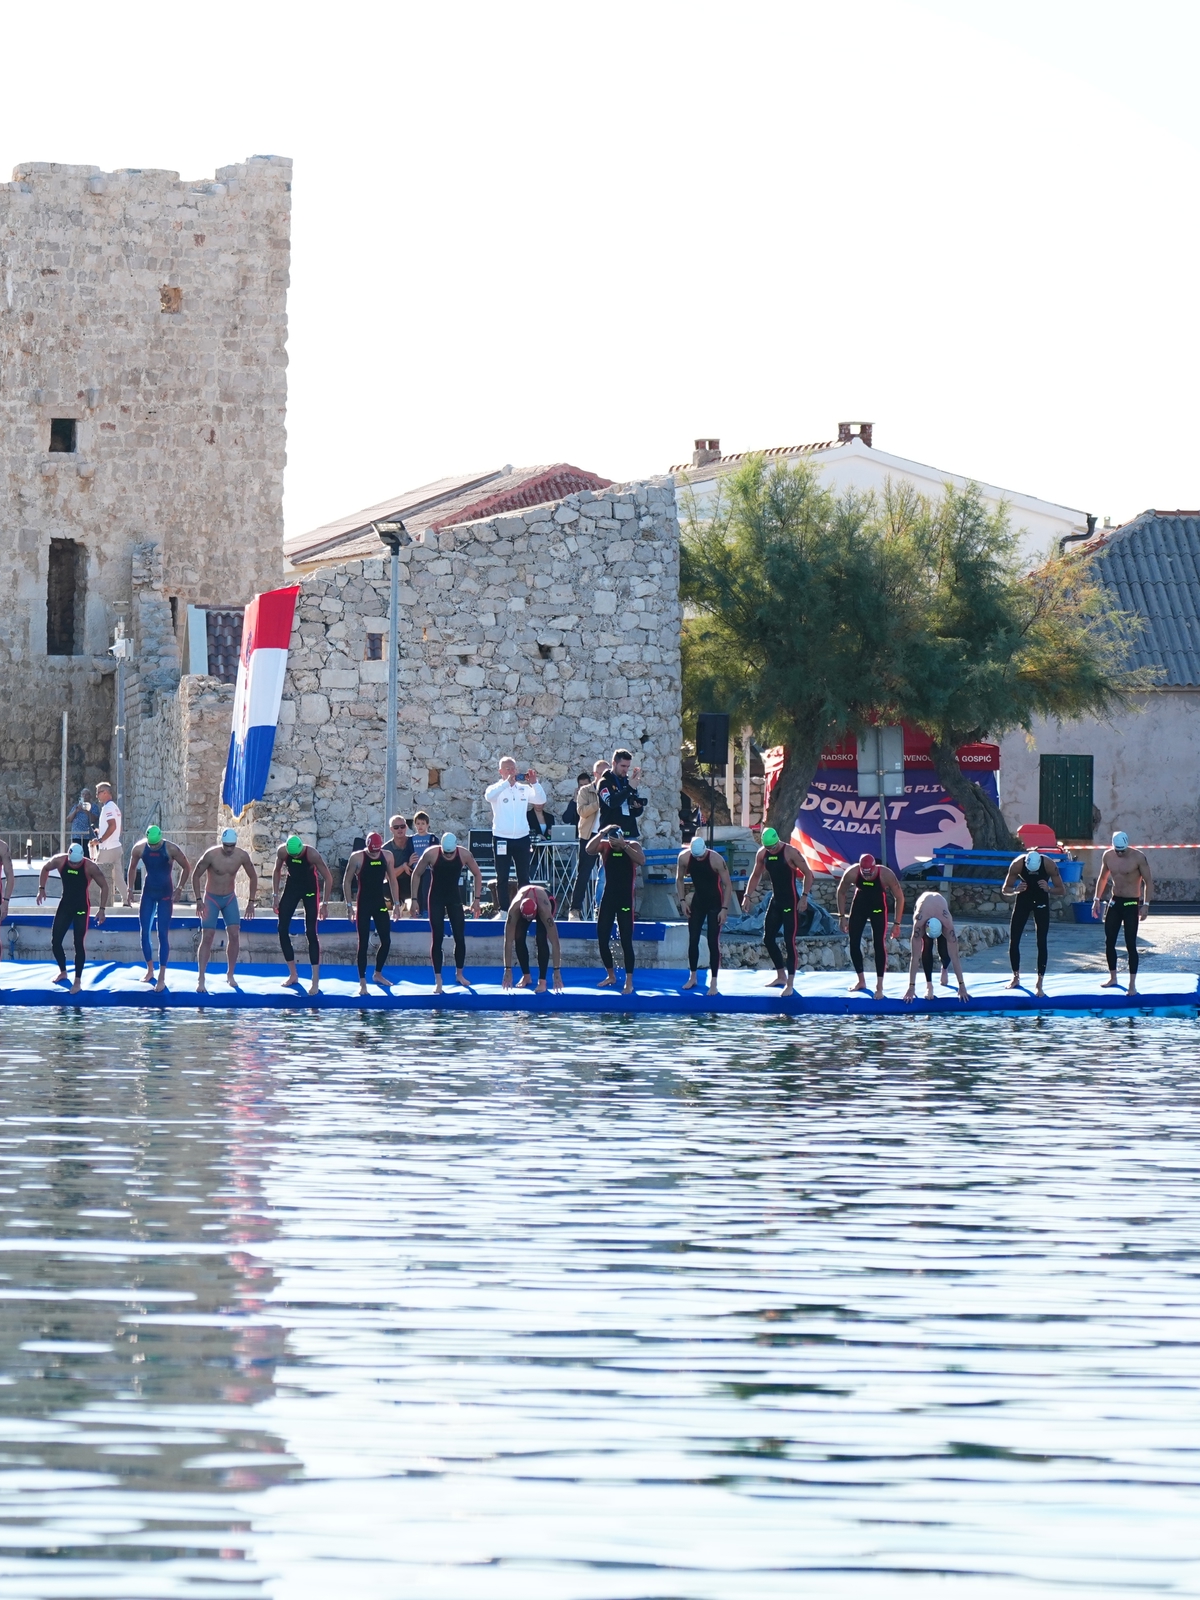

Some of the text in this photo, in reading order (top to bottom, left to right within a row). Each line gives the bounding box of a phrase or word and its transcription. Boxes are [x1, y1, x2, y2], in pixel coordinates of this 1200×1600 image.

[821, 754, 854, 762] RADSKO
[961, 754, 992, 763] GOSPIĆ
[800, 794, 910, 820] DONAT
